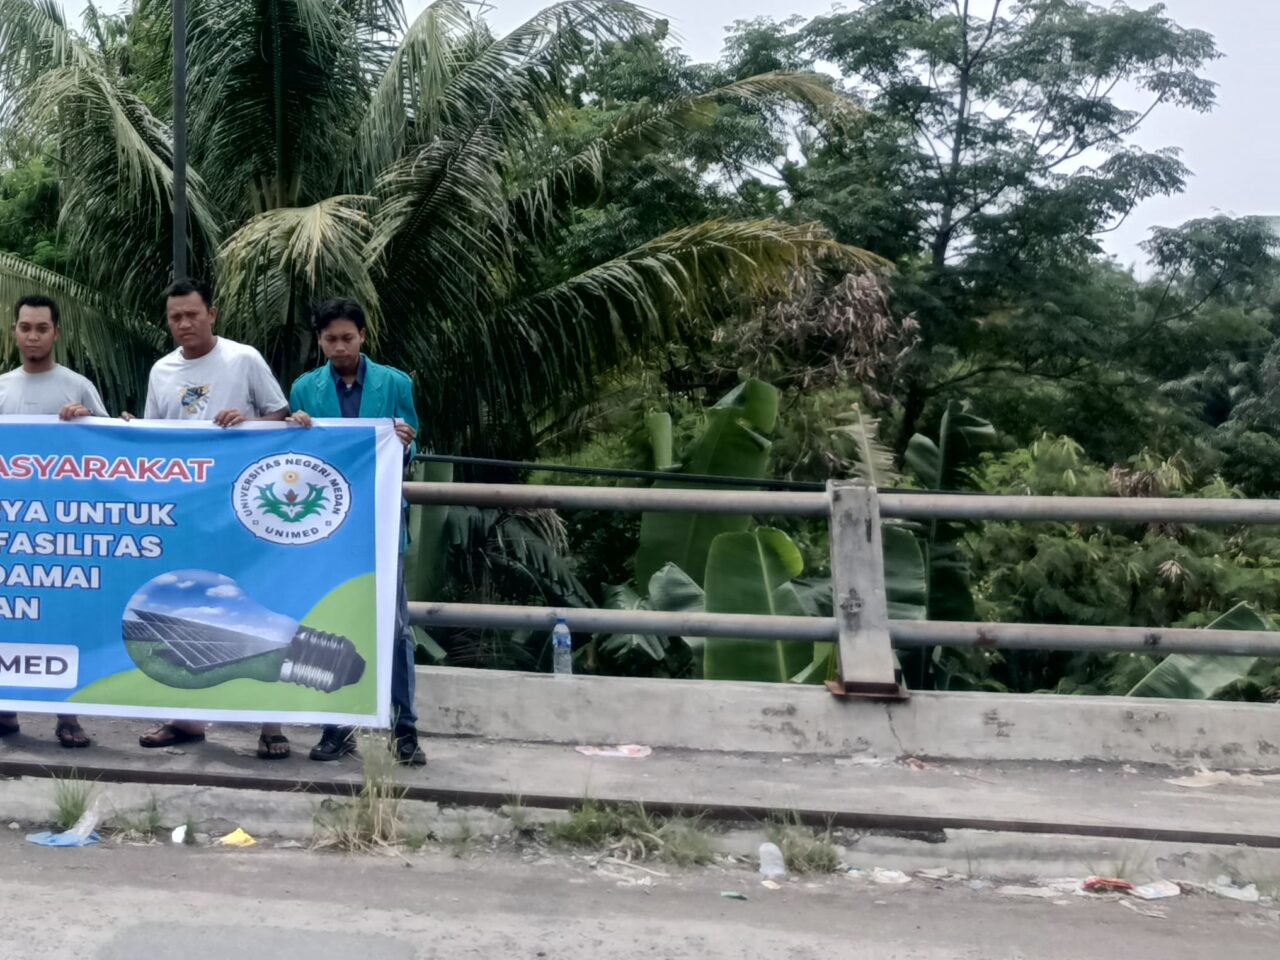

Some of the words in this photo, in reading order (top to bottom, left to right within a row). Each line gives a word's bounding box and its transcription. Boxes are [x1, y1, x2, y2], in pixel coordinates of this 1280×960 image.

[240, 459, 281, 517] UNIVERSITAS
[285, 458, 331, 478] NEGERI
[329, 478, 344, 515] MEDAN
[55, 501, 177, 526] UNTUK
[265, 526, 320, 538] UNIMED
